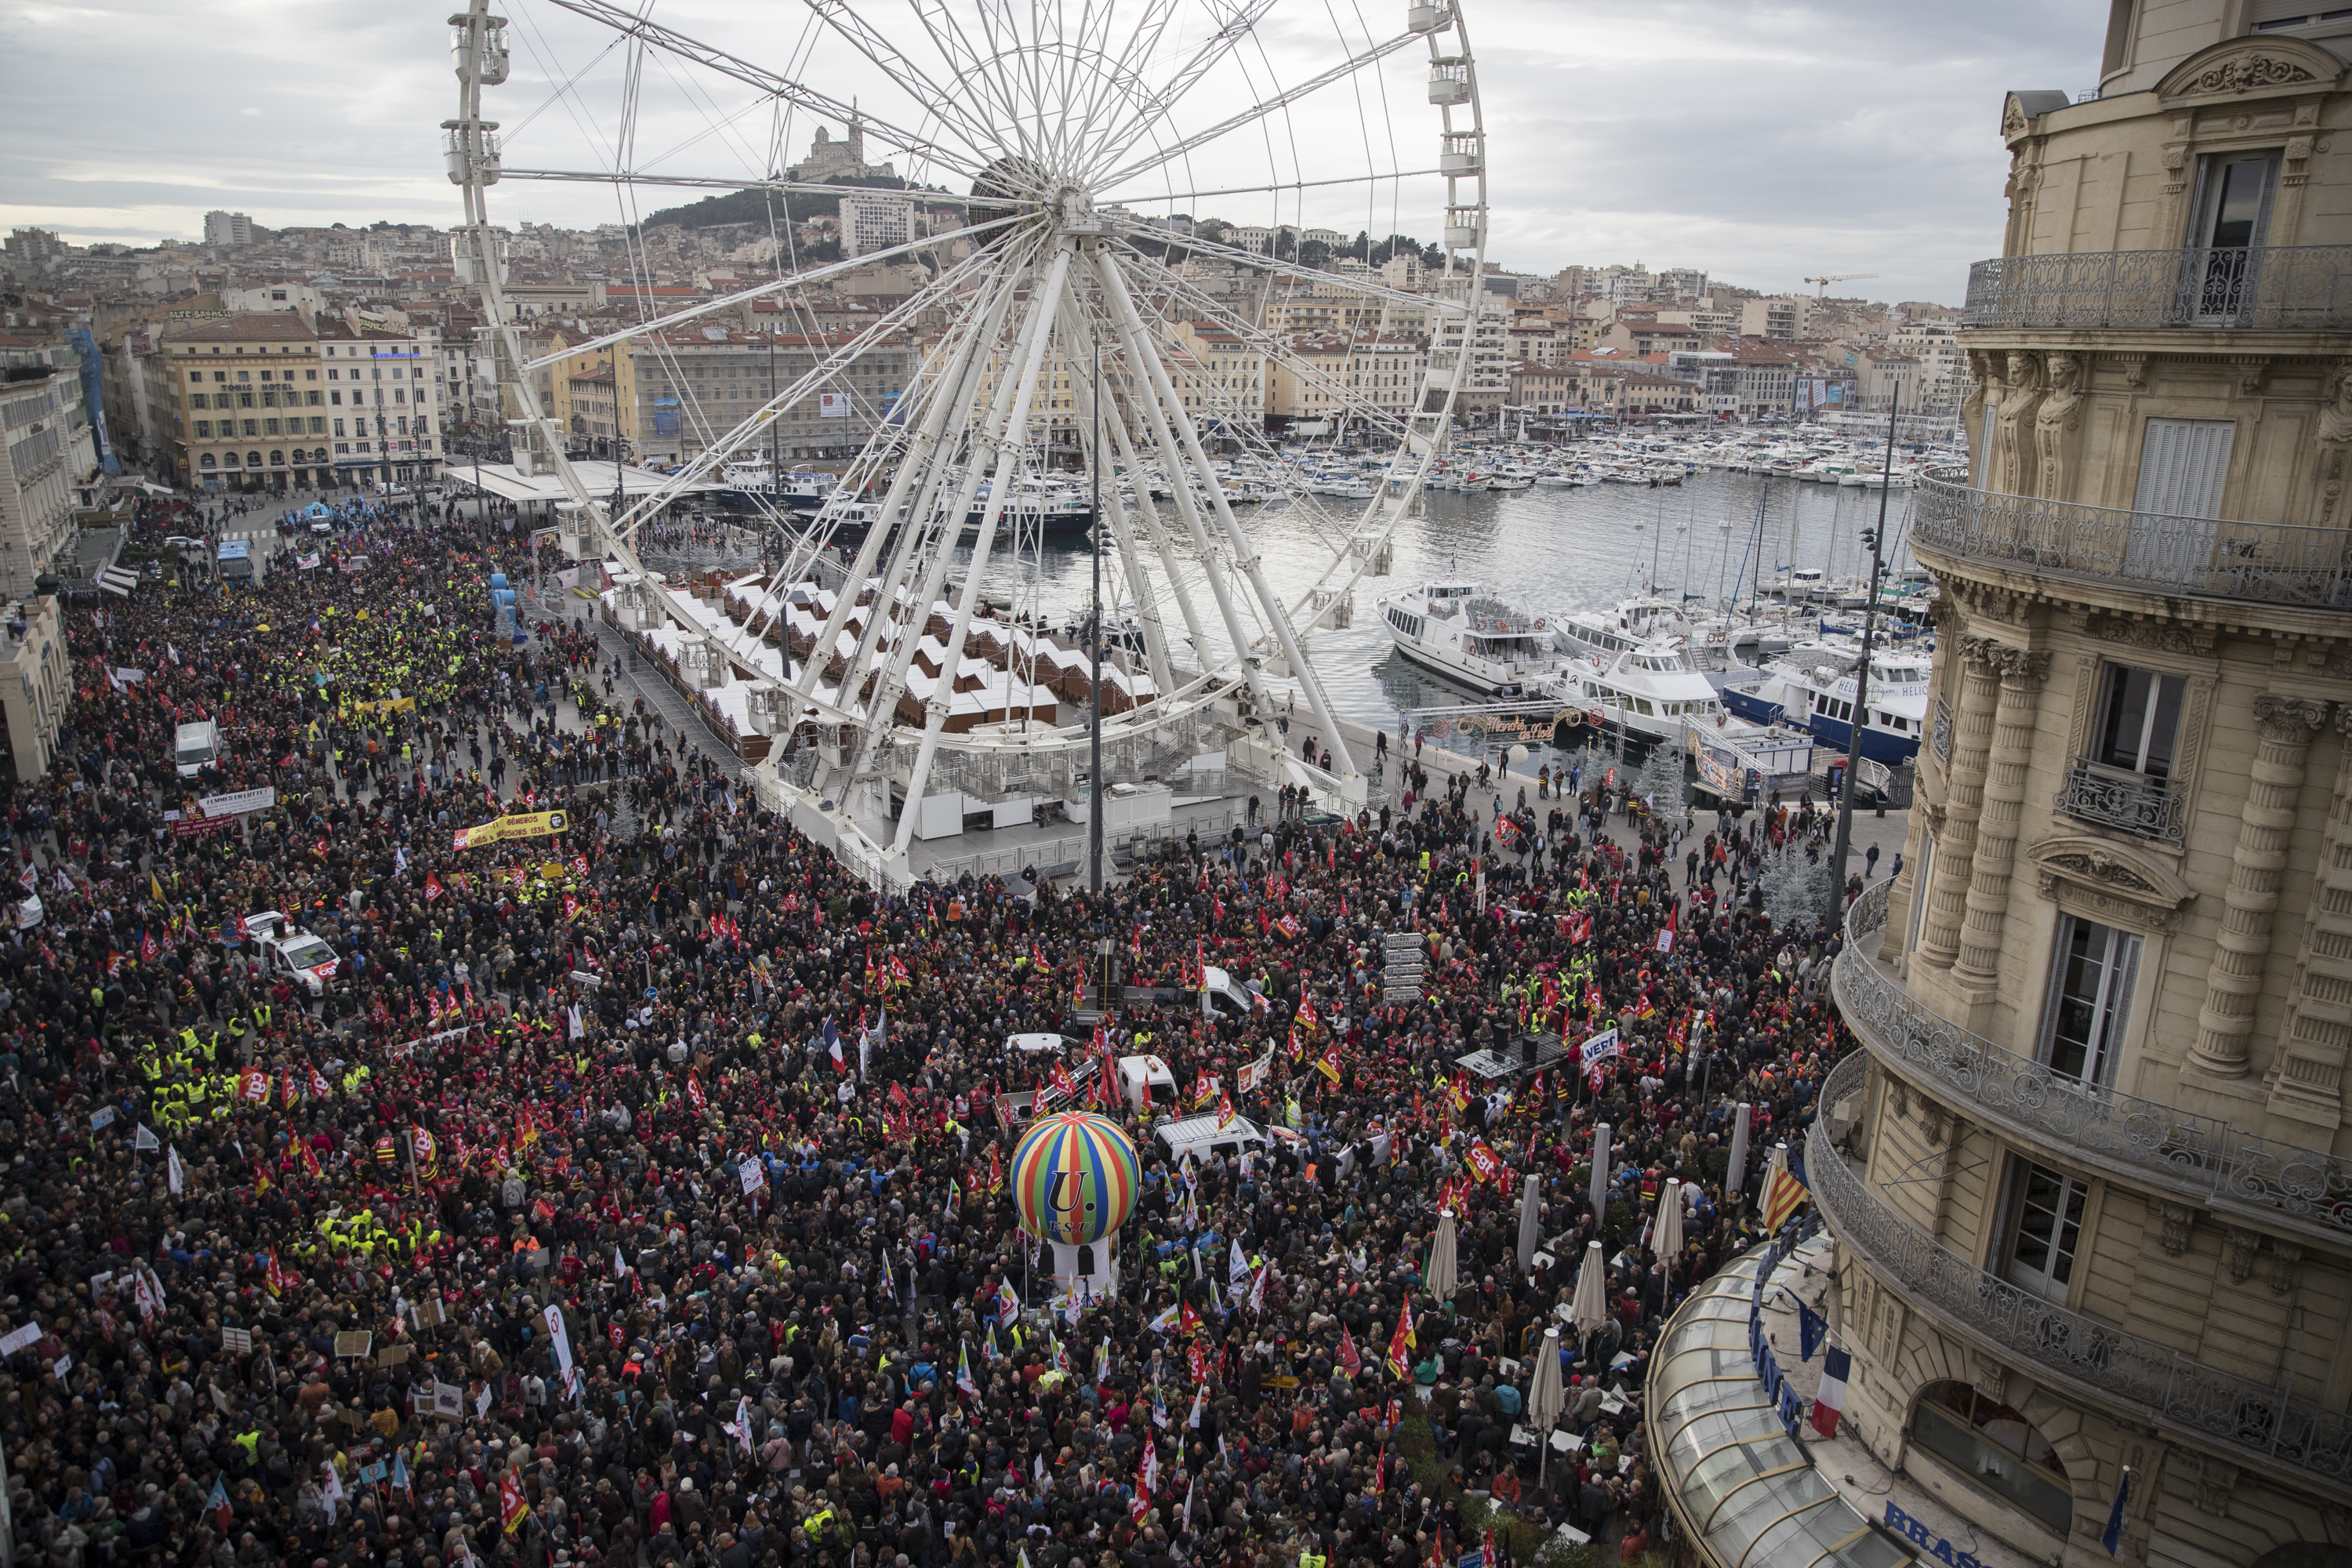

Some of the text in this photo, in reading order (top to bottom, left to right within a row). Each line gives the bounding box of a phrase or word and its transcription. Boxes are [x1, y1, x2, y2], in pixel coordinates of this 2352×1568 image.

[207, 796, 233, 804] FEMMES
[507, 816, 538, 826] GÉMENOS
[454, 835, 468, 846] cgt
[470, 835, 487, 846] THÉS
[531, 826, 545, 834] 1336
[1281, 915, 1298, 931] PCF
[245, 1072, 266, 1100] cgt
[1471, 1149, 1494, 1175] cgt
[1048, 1170, 1096, 1212] U.
[1049, 1221, 1094, 1233] F.S.U.
